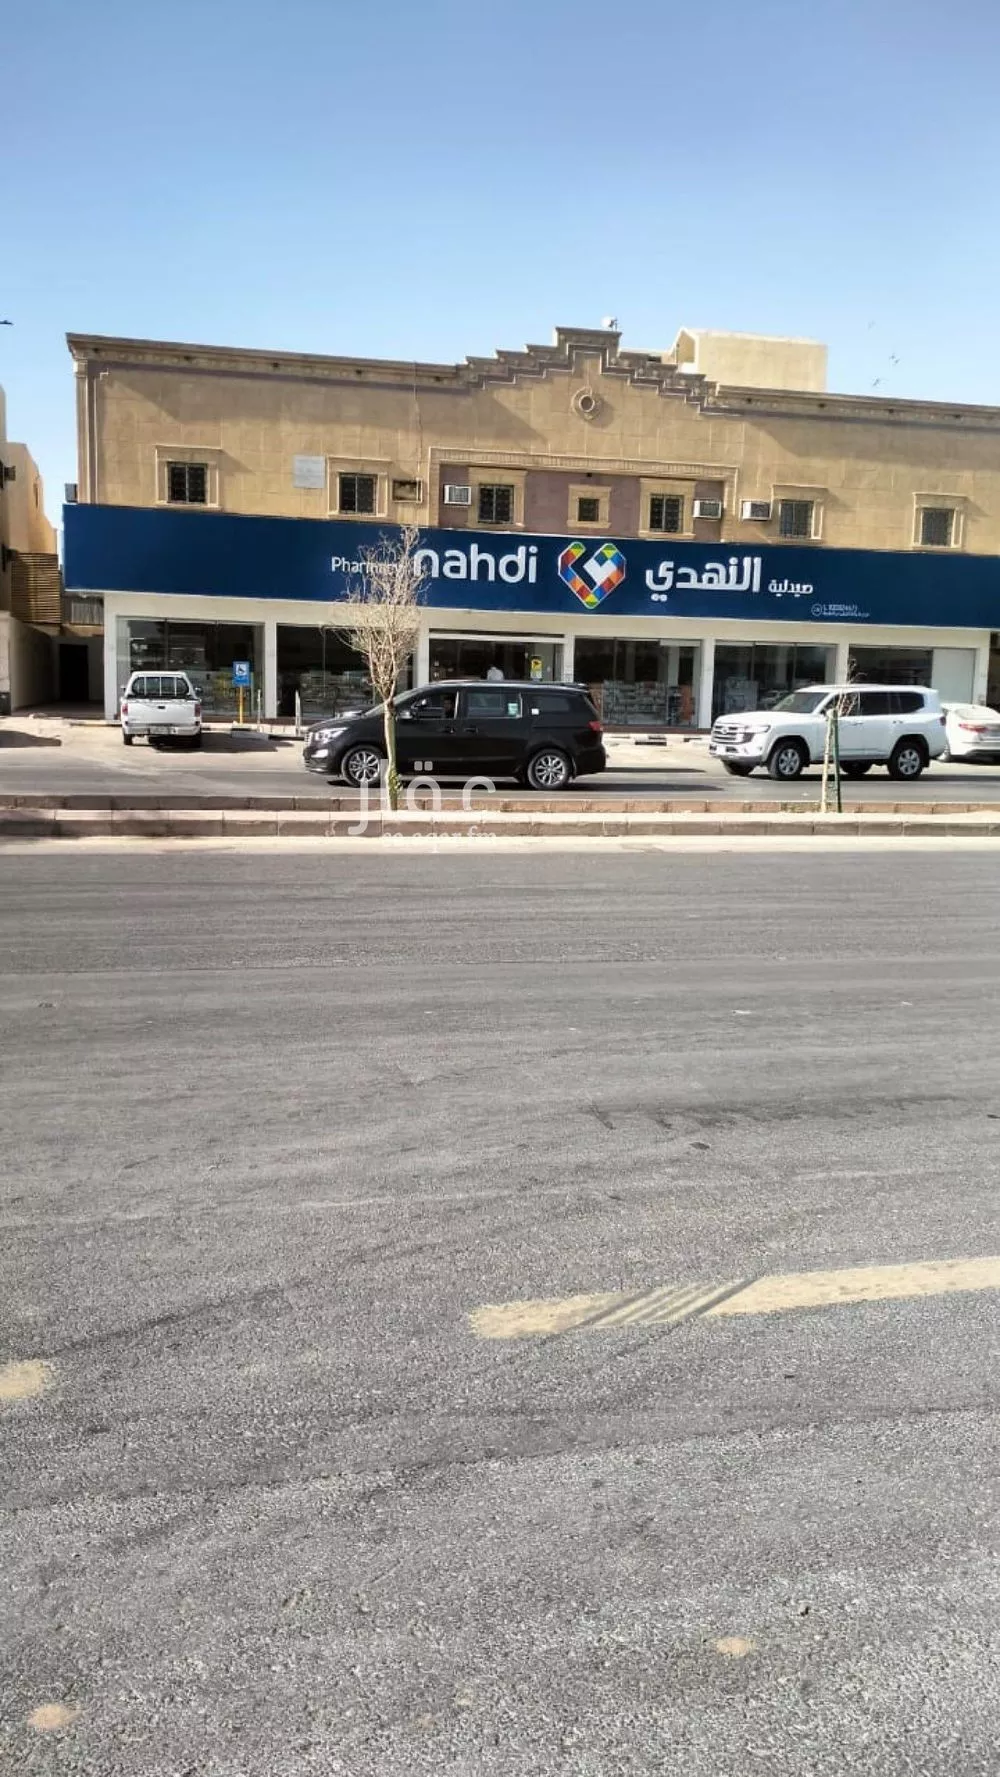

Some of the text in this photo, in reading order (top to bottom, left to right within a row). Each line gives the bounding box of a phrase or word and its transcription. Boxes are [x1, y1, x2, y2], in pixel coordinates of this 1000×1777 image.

[331, 543, 538, 584] Pharm nahdi
[645, 556, 814, 602] صيدلية النهدي
